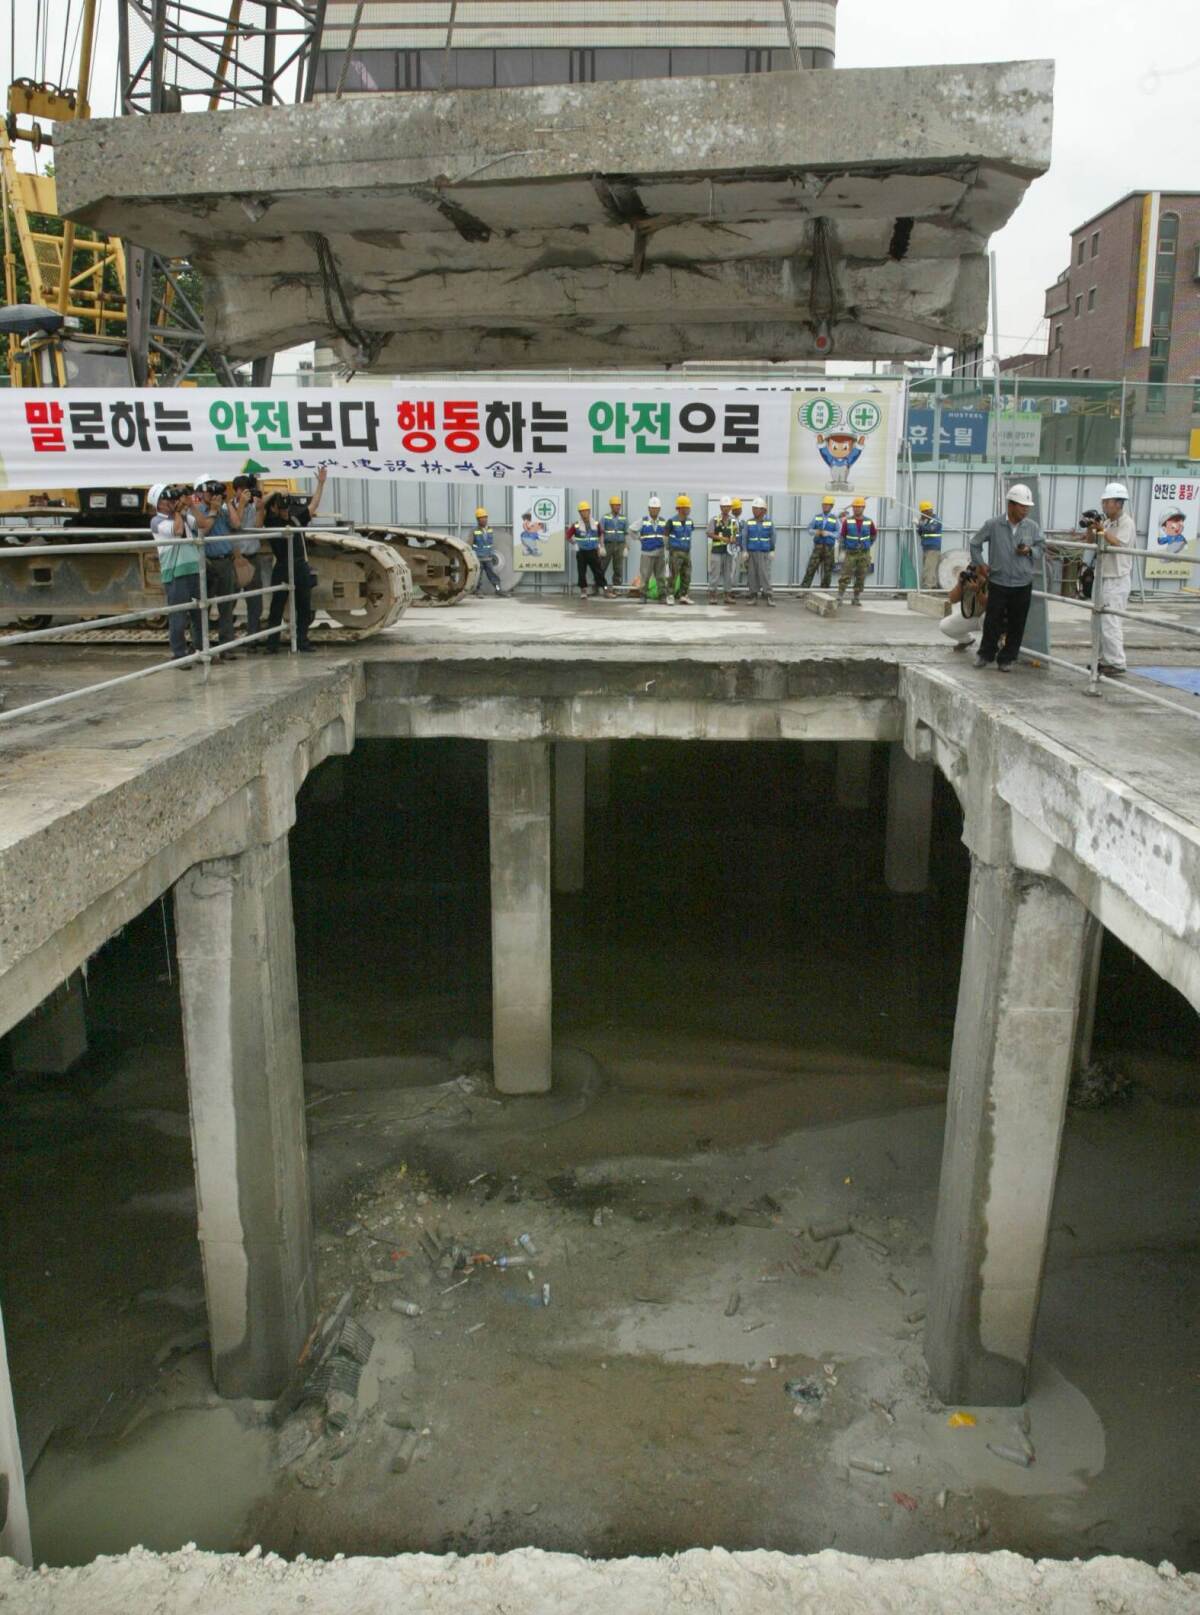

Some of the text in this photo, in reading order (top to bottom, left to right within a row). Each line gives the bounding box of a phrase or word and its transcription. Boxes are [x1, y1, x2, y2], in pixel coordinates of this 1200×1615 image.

[25, 401, 759, 454] 말로하는 안전보다 행동하는 안전으로
[908, 425, 973, 447] 휴스틸
[1154, 484, 1176, 500] 안전은
